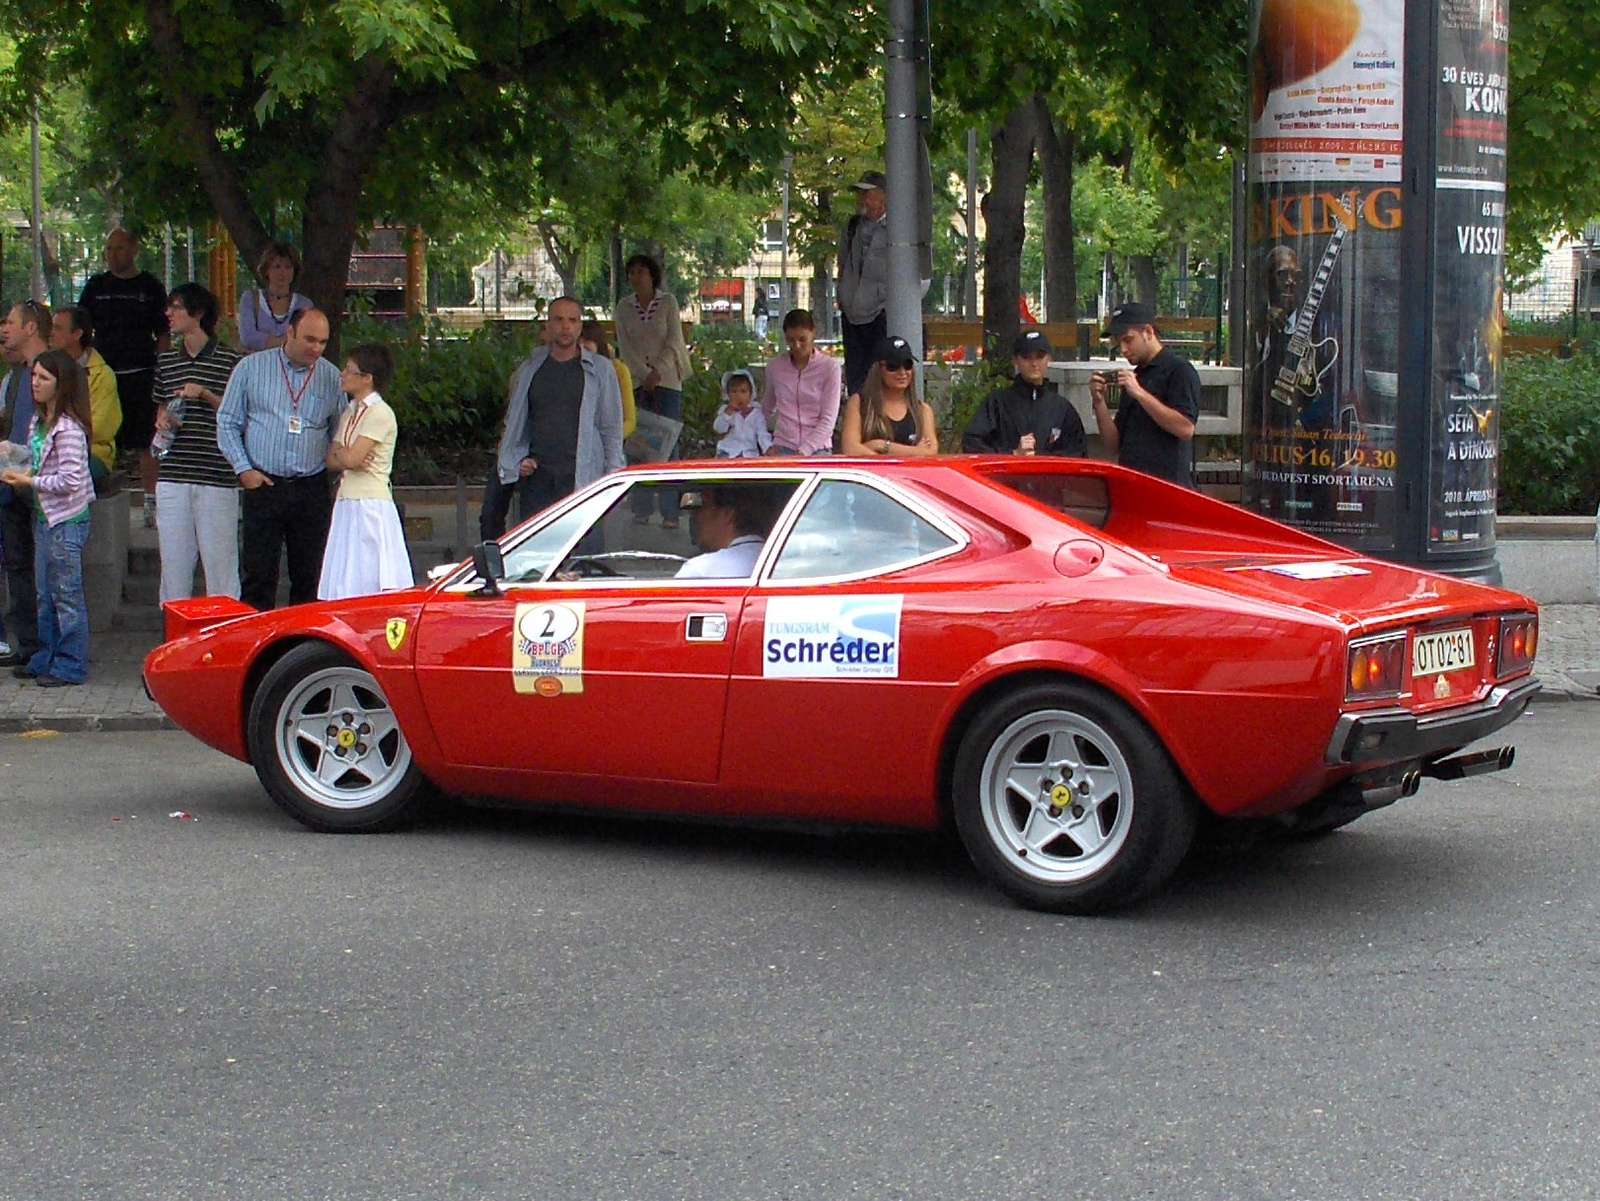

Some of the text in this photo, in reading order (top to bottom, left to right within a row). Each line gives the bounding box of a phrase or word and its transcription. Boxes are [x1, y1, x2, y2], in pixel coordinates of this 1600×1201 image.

[1442, 67, 1456, 82] 30
[1460, 67, 1484, 86] ÉVES
[1270, 187, 1403, 239] KING
[1447, 407, 1475, 433] SÉTA
[1310, 447, 1336, 467] 16.
[1344, 449, 1397, 469] 19.30
[1447, 441, 1457, 460] A
[1262, 471, 1311, 485] BUDAPEST
[1312, 473, 1395, 488] SPORTARÉNA
[540, 609, 556, 638] 2
[769, 622, 831, 634] TUNGSRAM
[766, 637, 895, 663] Schréder
